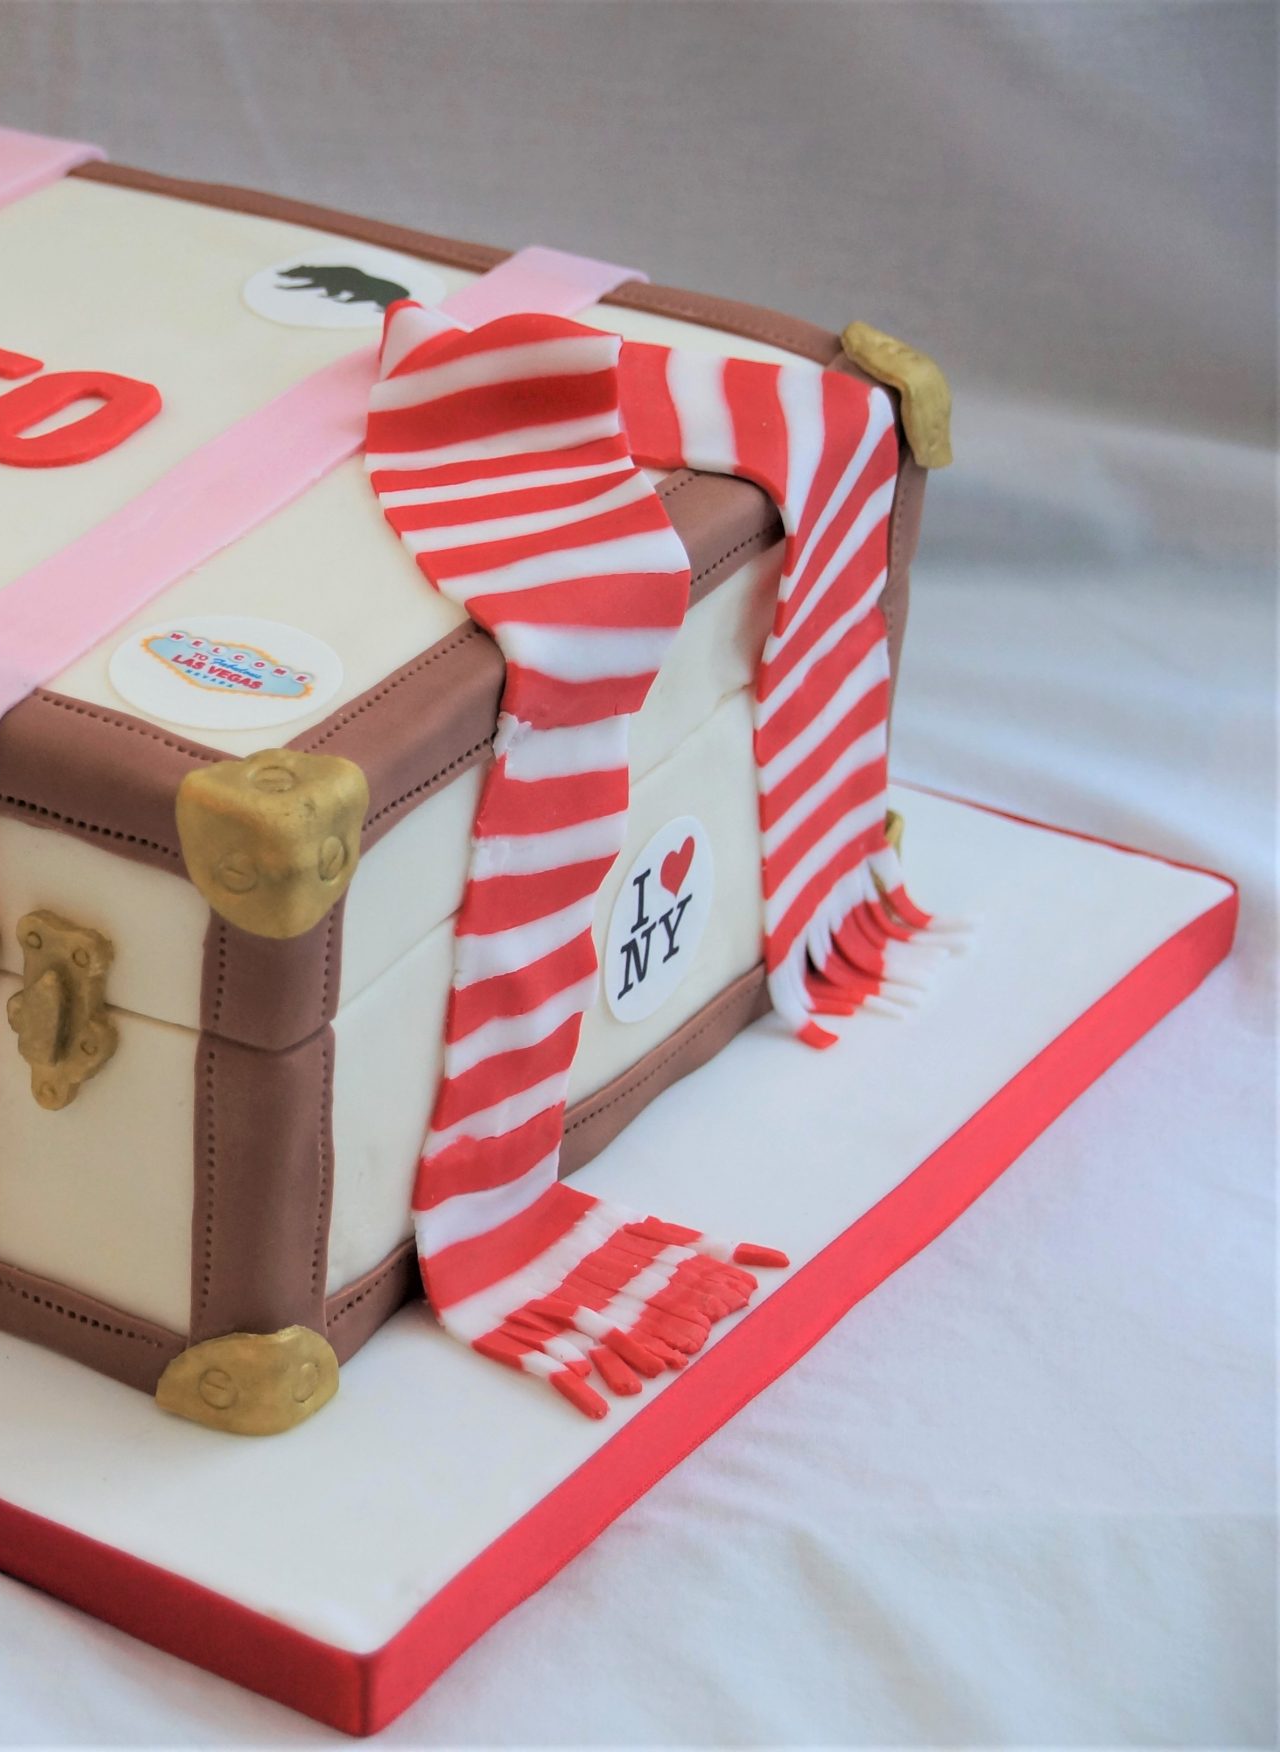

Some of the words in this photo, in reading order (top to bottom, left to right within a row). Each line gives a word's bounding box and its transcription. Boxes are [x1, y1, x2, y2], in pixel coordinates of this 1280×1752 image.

[170, 632, 308, 682] WELCOME
[171, 654, 206, 670] LAS
[207, 665, 264, 690] VEGAS
[186, 668, 234, 688] NEVADA
[192, 652, 209, 662] TO
[210, 656, 263, 680] Fabulous
[631, 868, 651, 934] I
[617, 893, 693, 1001] NY
